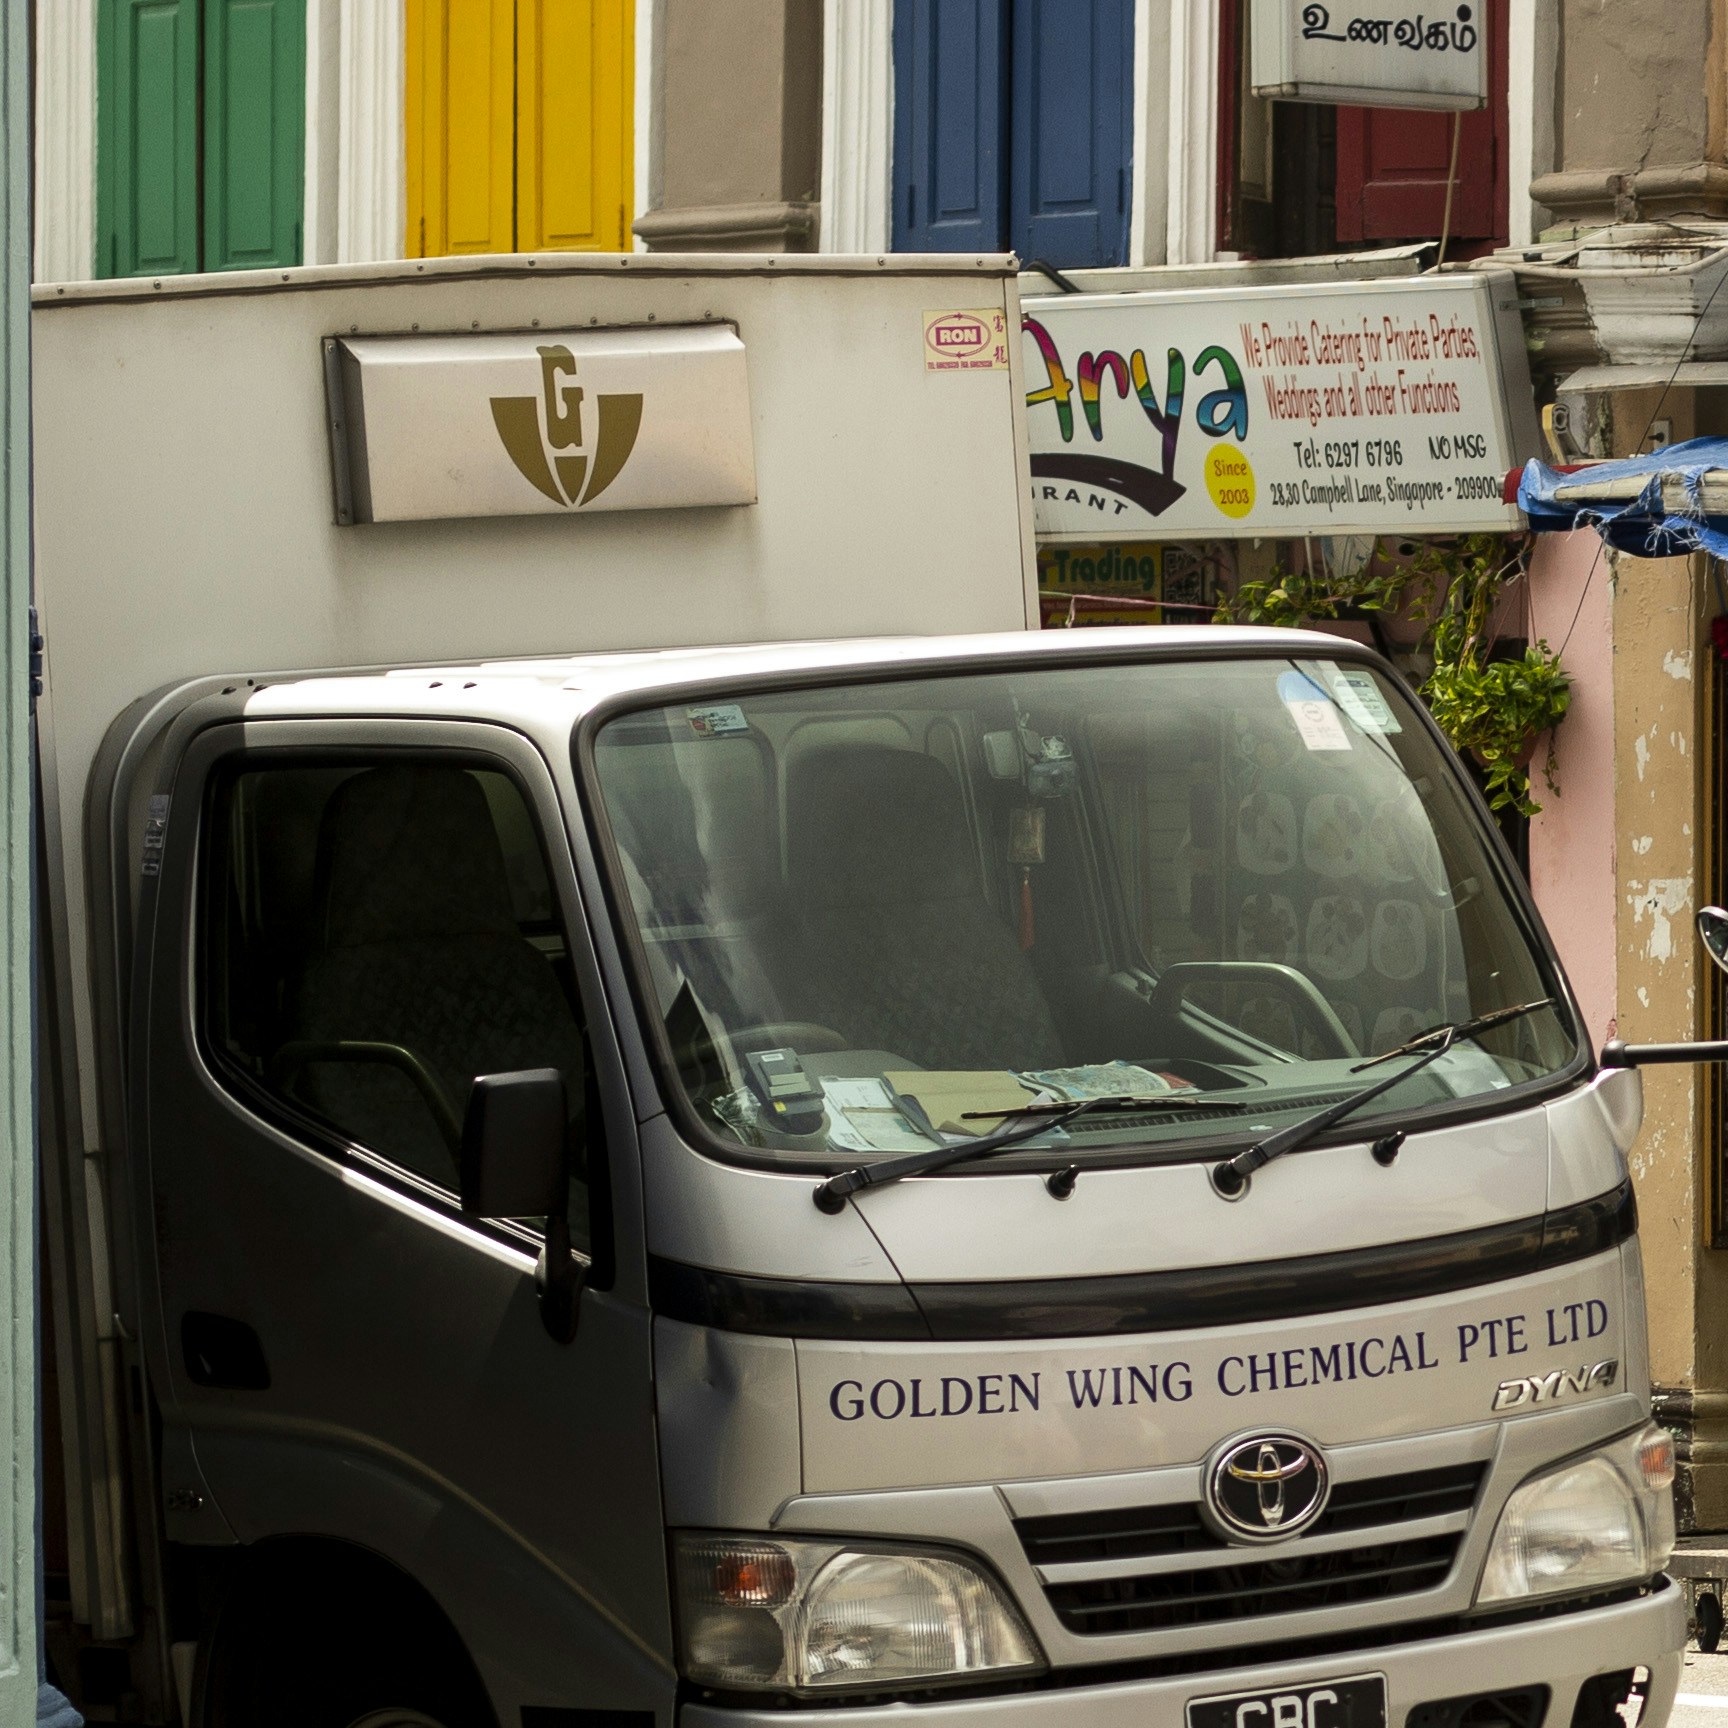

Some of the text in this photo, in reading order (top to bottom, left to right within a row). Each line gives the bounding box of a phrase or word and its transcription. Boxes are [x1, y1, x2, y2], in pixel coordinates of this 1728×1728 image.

[1301, 3, 1476, 52] உணவகம்
[940, 328, 978, 343] RON
[1240, 312, 1481, 372] We Provide Catering for Private Parties,
[1020, 318, 1250, 486] Arya
[1262, 367, 1461, 427] Weddings and all other Functions
[1214, 459, 1248, 477] Since
[1293, 434, 1487, 468] Tel: 6297 6796 NO MSG
[1219, 488, 1250, 505] 2003
[1270, 483, 1299, 508] 28,30
[1302, 475, 1354, 513] Campbell
[1355, 478, 1386, 505] Lane,
[1386, 476, 1444, 511] Singapore
[1054, 548, 1155, 591] Trading
[829, 1297, 1610, 1422] GOLDEN WING CHEMICAL PTE LTD
[1491, 1359, 1619, 1411] DYNA
